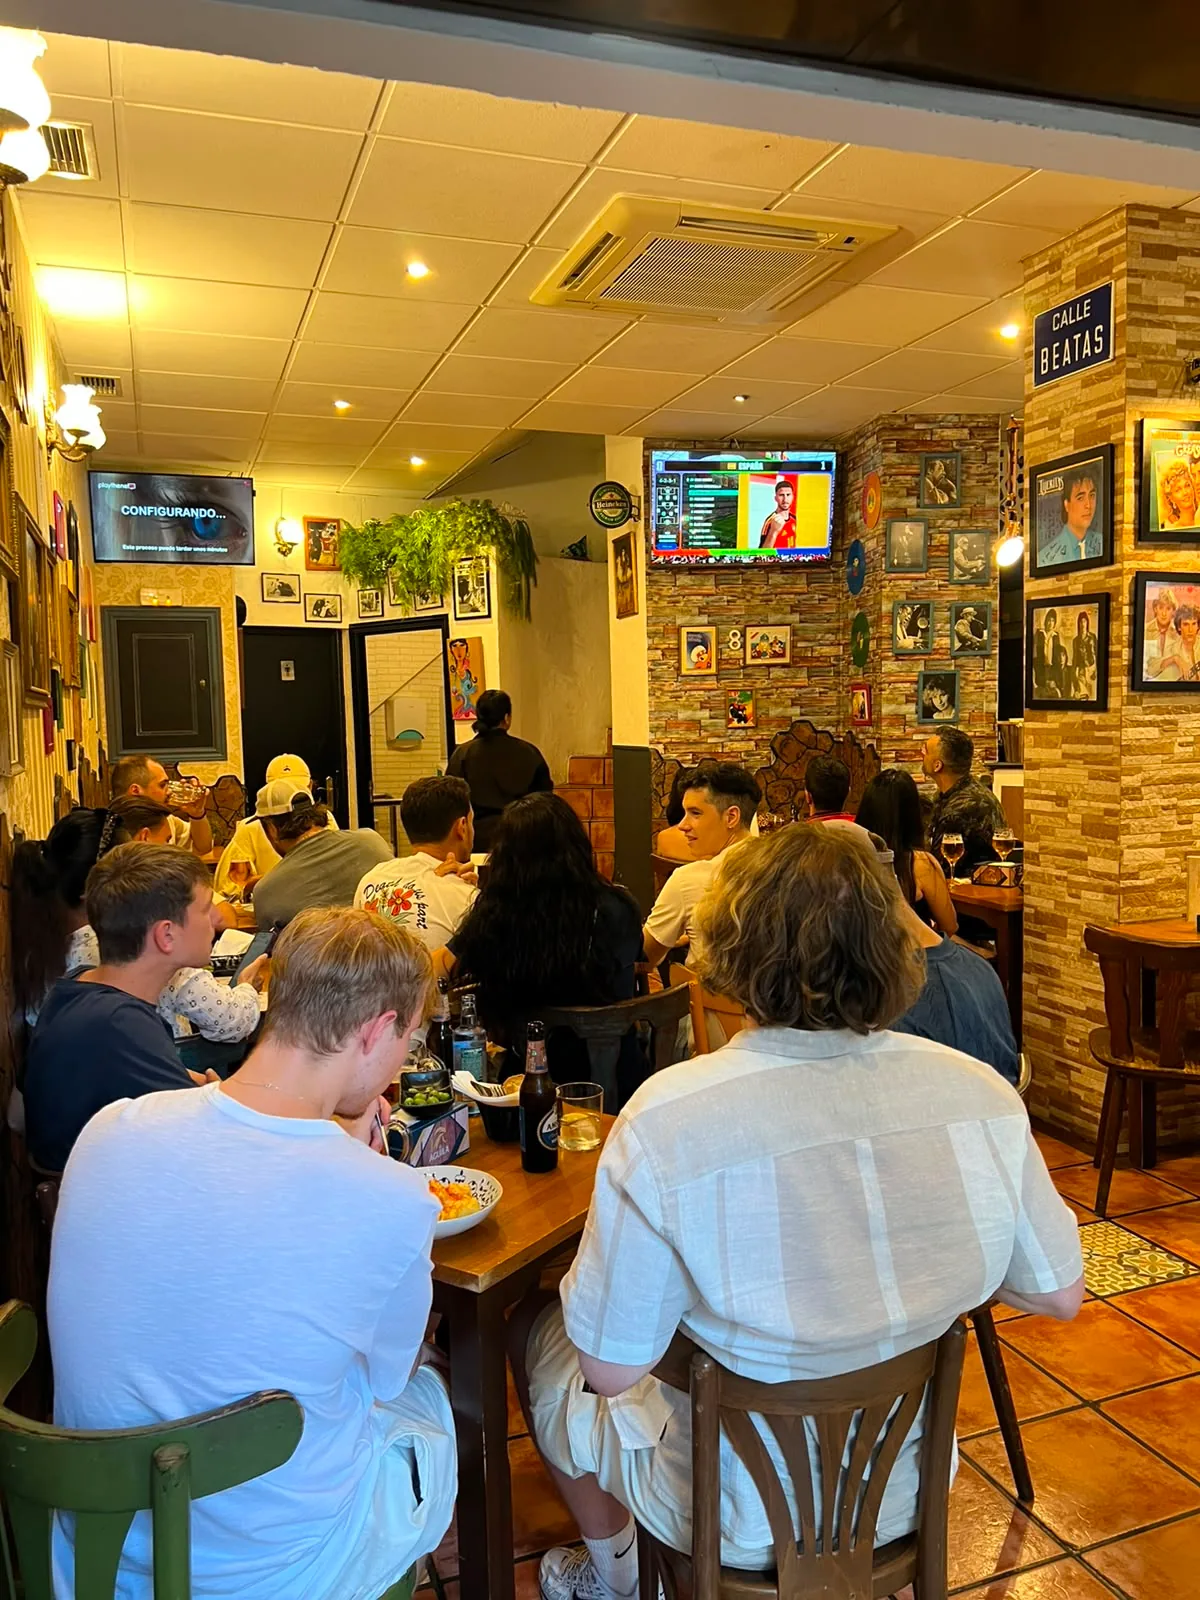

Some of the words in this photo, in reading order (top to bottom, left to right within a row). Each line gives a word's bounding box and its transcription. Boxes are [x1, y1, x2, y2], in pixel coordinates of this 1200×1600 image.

[1052, 298, 1091, 331] CALLE
[1040, 324, 1104, 375] BEATAS
[1175, 443, 1200, 459] GREAS
[820, 461, 826, 471] 1
[121, 505, 226, 519] CONFIGURANDO...
[596, 501, 628, 509] Heineken
